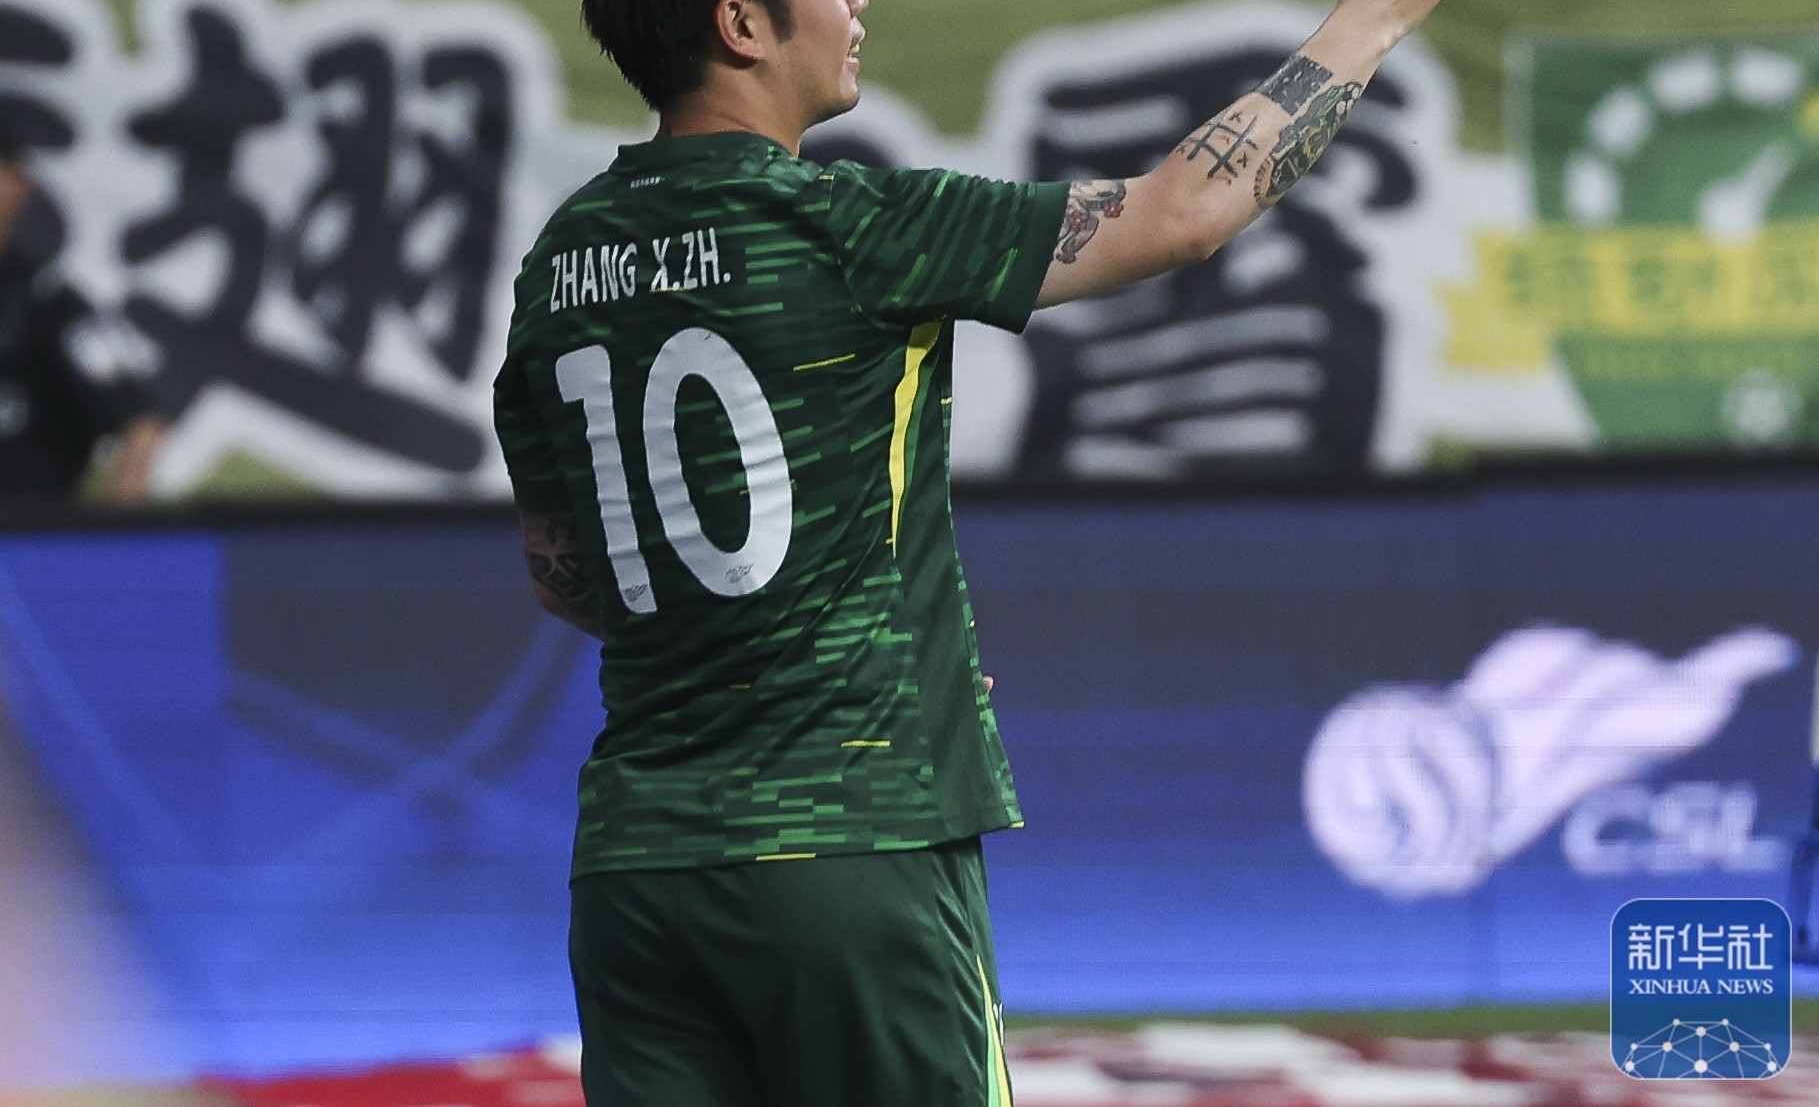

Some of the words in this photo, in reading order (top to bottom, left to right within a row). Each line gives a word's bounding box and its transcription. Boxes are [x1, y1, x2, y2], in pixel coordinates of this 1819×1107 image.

[550, 242, 637, 313] ZHANG
[650, 227, 731, 292] X.ZH.
[555, 326, 793, 614] 10
[1562, 781, 1786, 875] CSL
